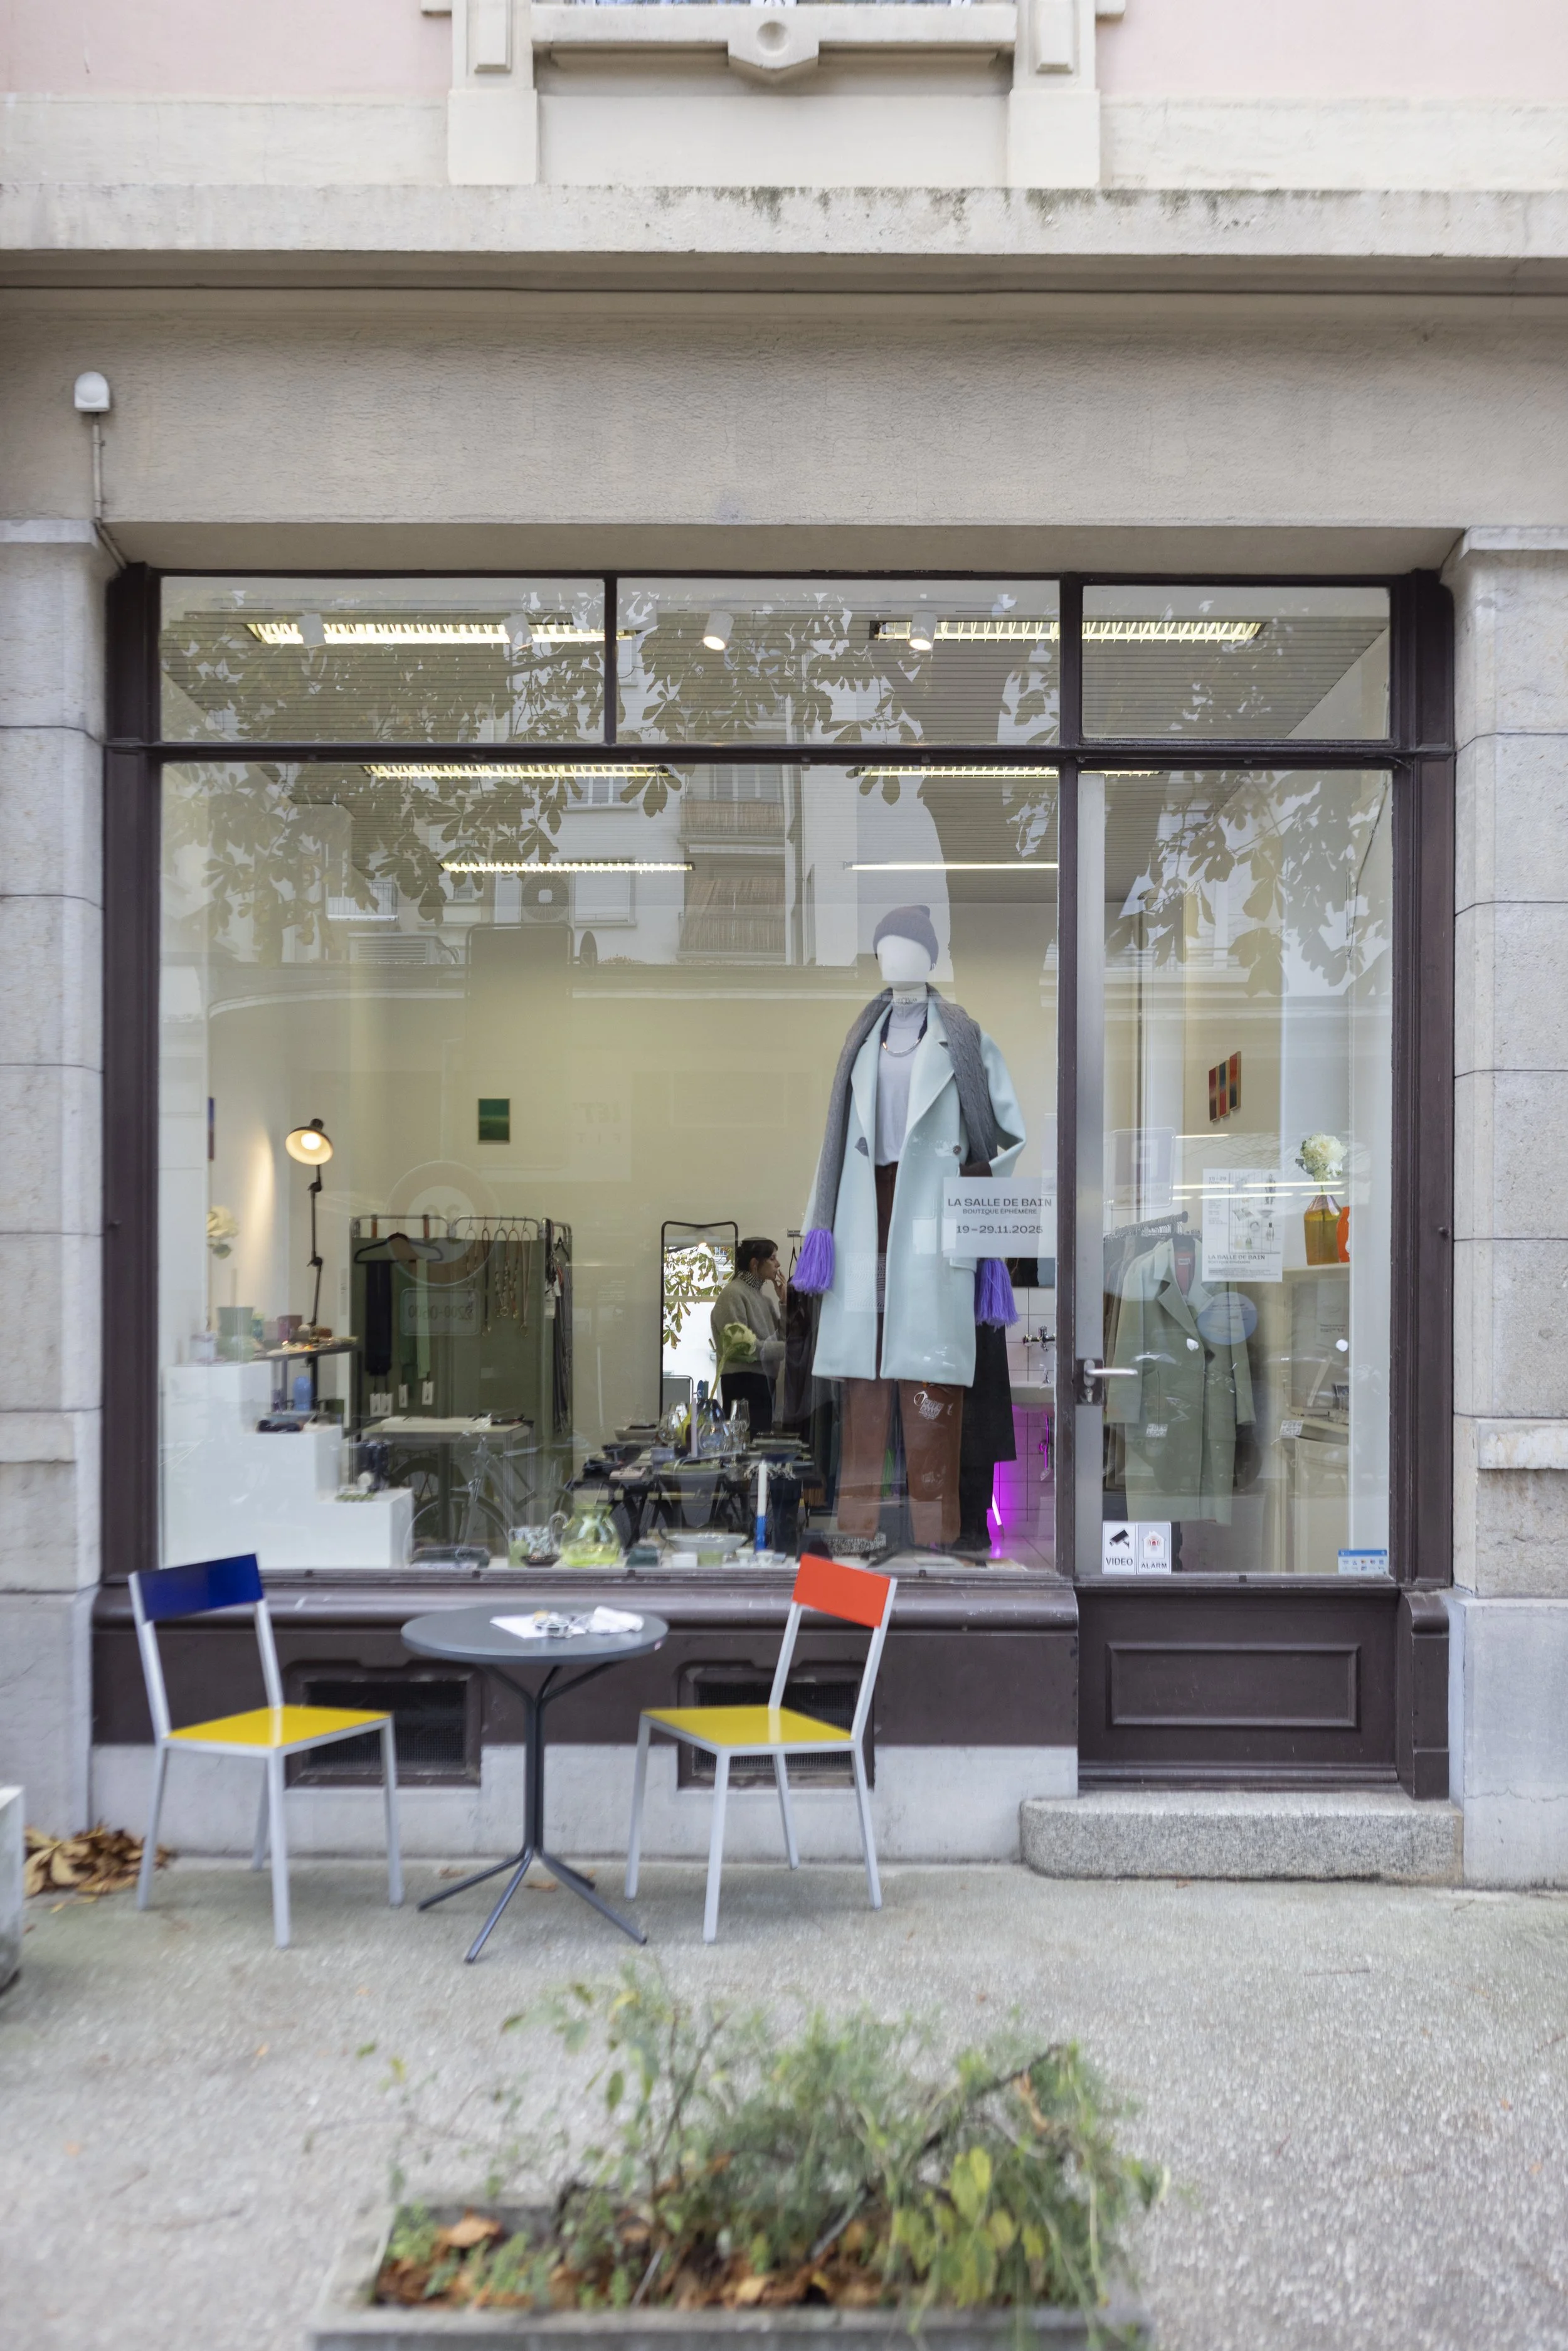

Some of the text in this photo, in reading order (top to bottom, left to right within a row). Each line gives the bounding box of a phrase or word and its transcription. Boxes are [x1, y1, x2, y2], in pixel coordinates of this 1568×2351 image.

[948, 1198, 1052, 1207] LA SALLE DE BAIN
[1106, 1557, 1133, 1566] VIDEO
